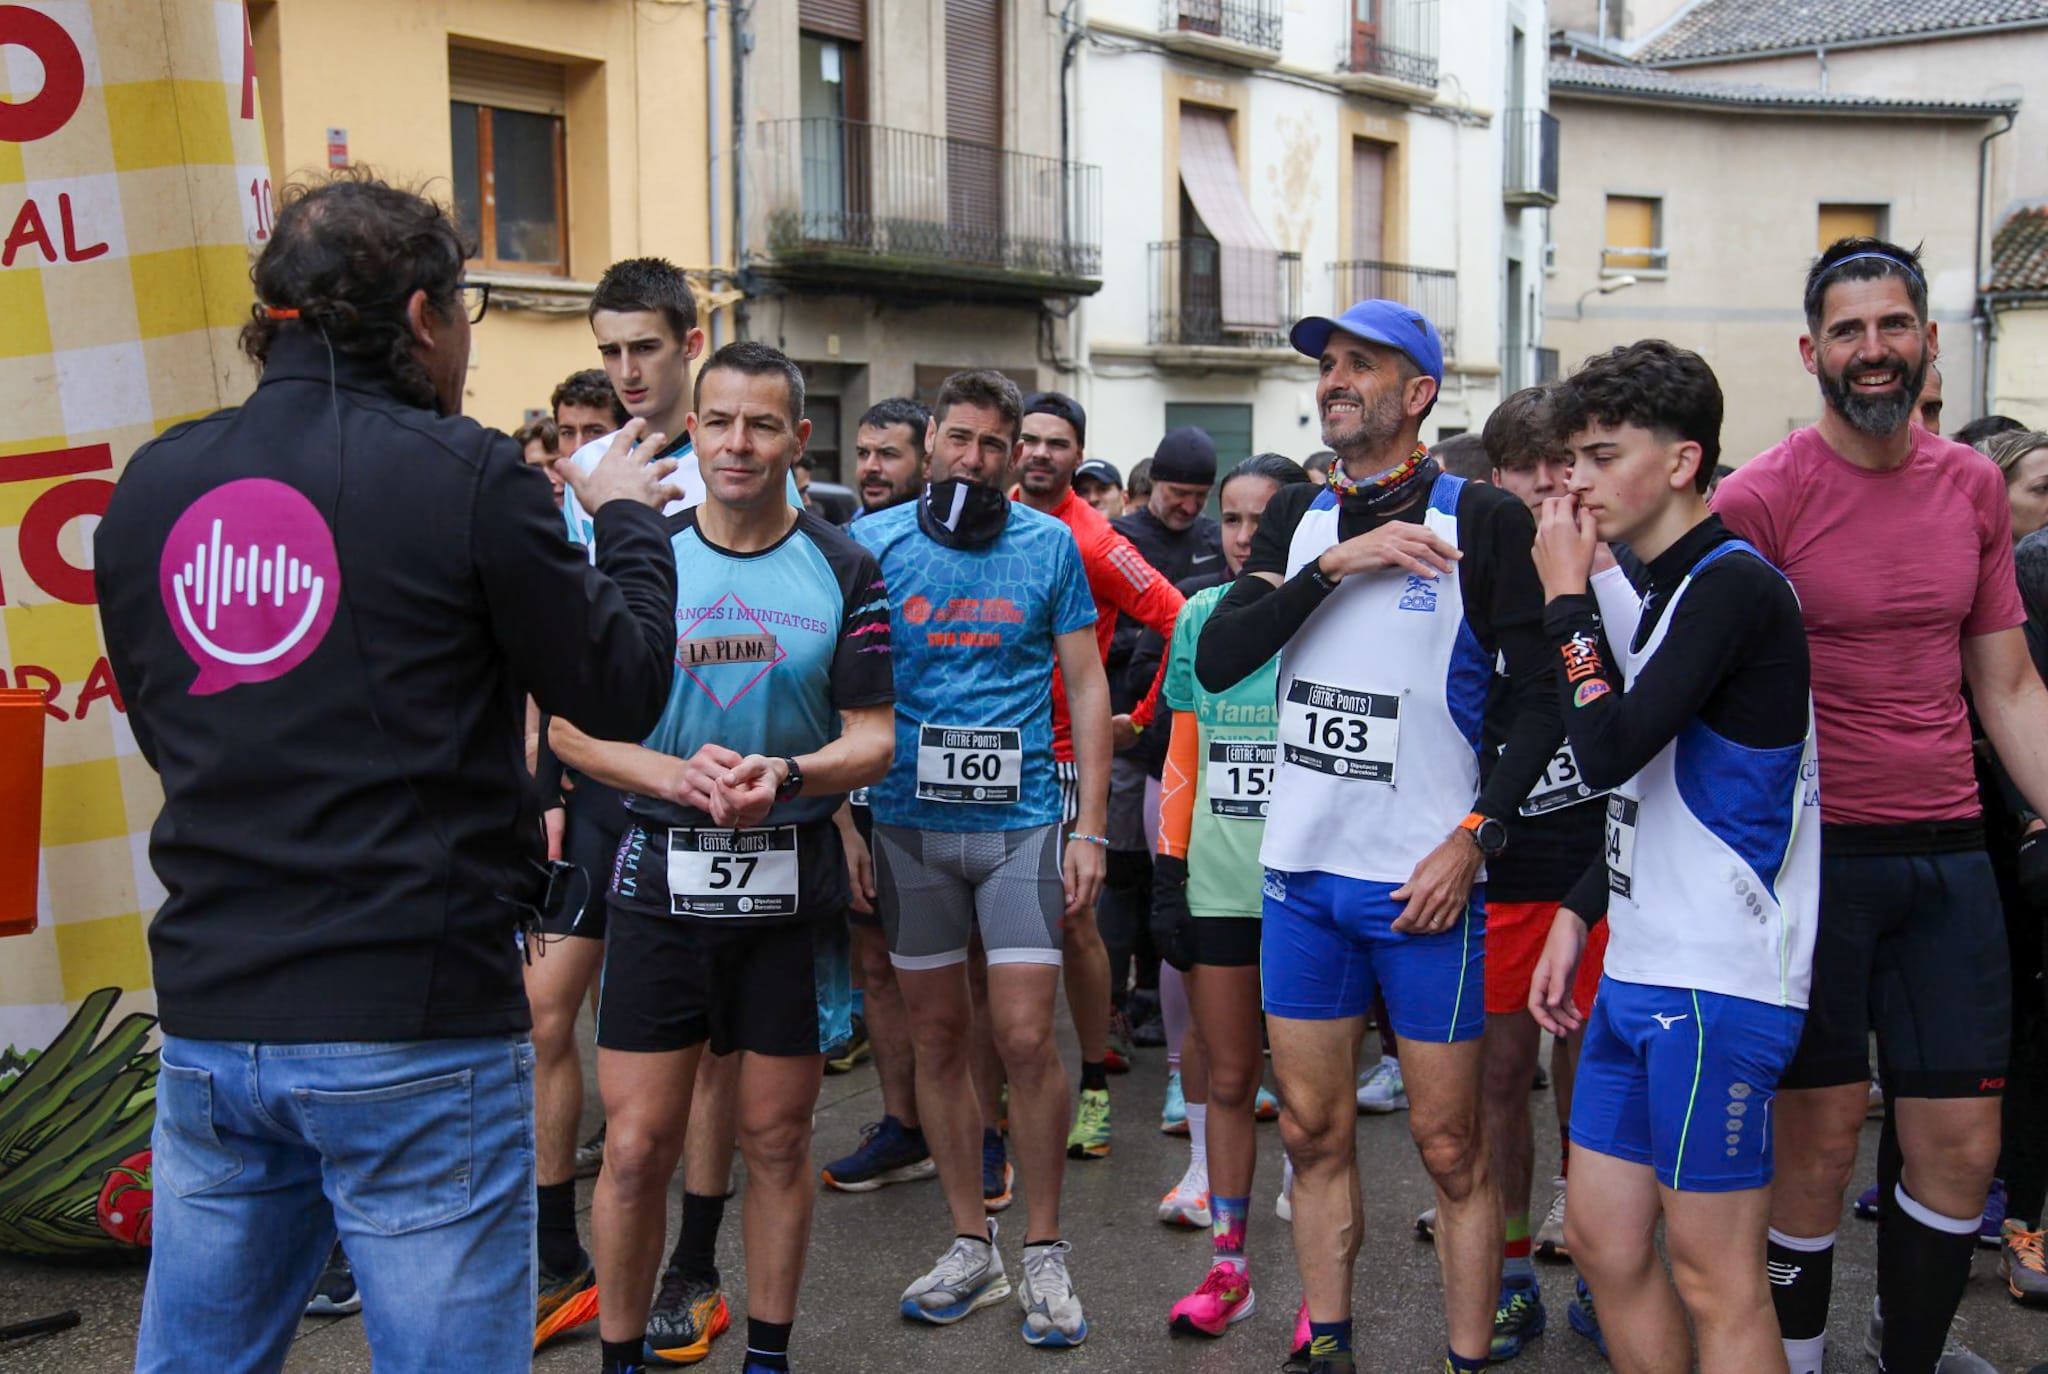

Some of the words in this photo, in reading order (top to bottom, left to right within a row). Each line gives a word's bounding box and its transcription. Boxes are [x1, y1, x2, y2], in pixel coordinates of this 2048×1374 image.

[1, 193, 109, 266] AL
[728, 608, 734, 620] I
[736, 608, 828, 634] MUNTATGES
[690, 643, 711, 662] LA
[716, 639, 766, 660] PLANA
[1311, 689, 1335, 707] ENTRE
[1336, 694, 1367, 713] PONTS
[946, 733, 970, 748] ENTRE
[972, 735, 998, 749] PONTS
[1305, 712, 1368, 753] 163
[942, 753, 1001, 781] 160
[1230, 748, 1254, 761] ENTRE
[703, 837, 732, 851] ENTRE
[709, 856, 759, 889] 57
